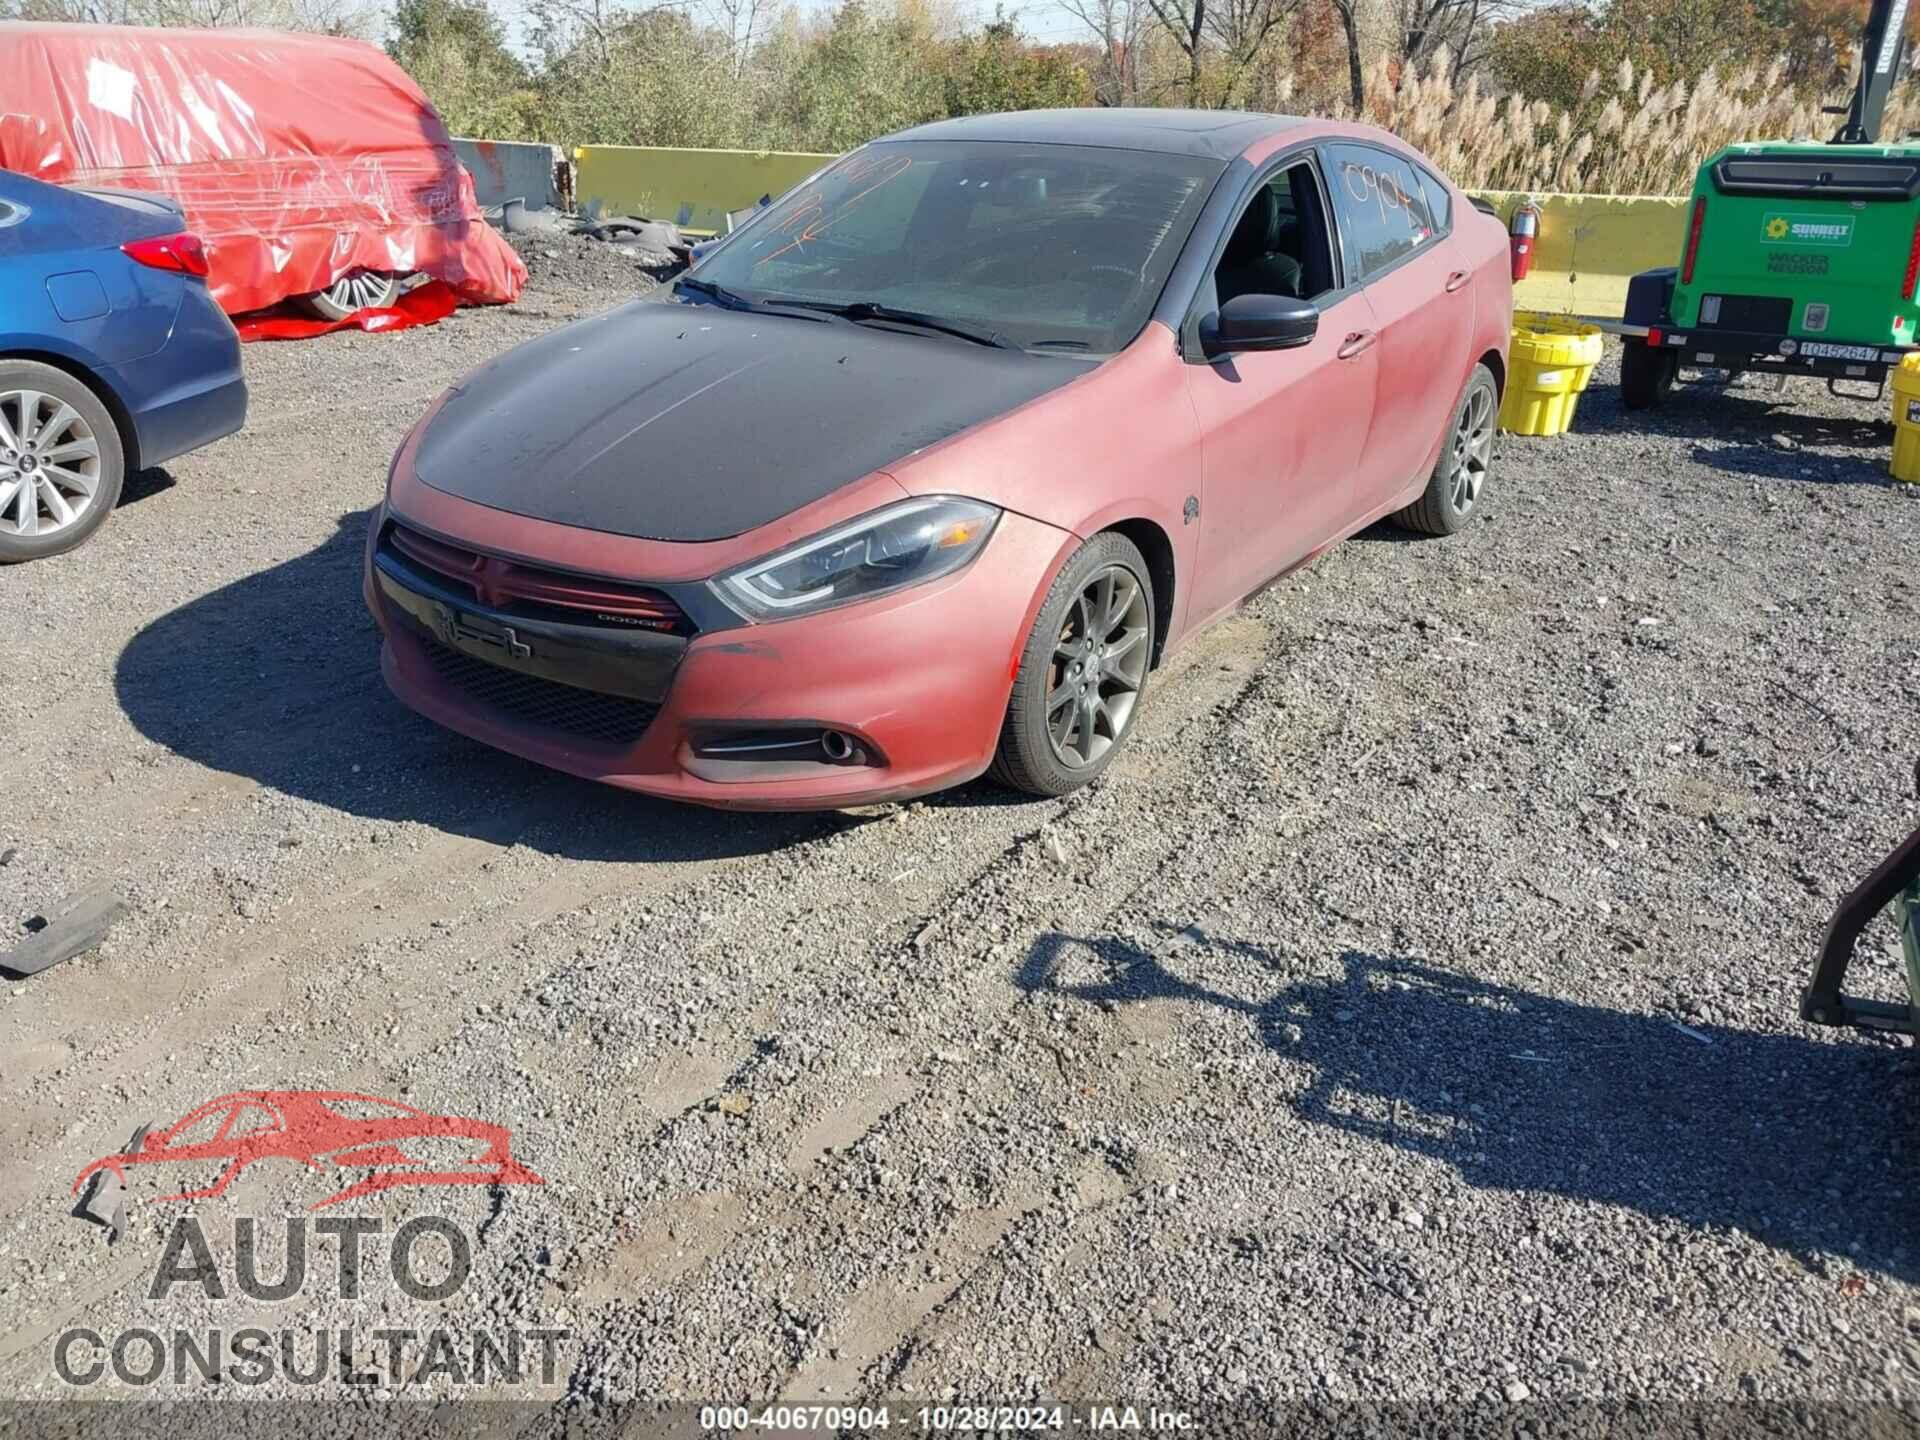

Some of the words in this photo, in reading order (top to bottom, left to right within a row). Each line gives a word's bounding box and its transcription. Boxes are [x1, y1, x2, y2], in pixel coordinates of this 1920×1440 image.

[1791, 223, 1849, 236] SUNBELT
[1768, 252, 1829, 264] WACKER
[598, 614, 673, 629] DODGE
